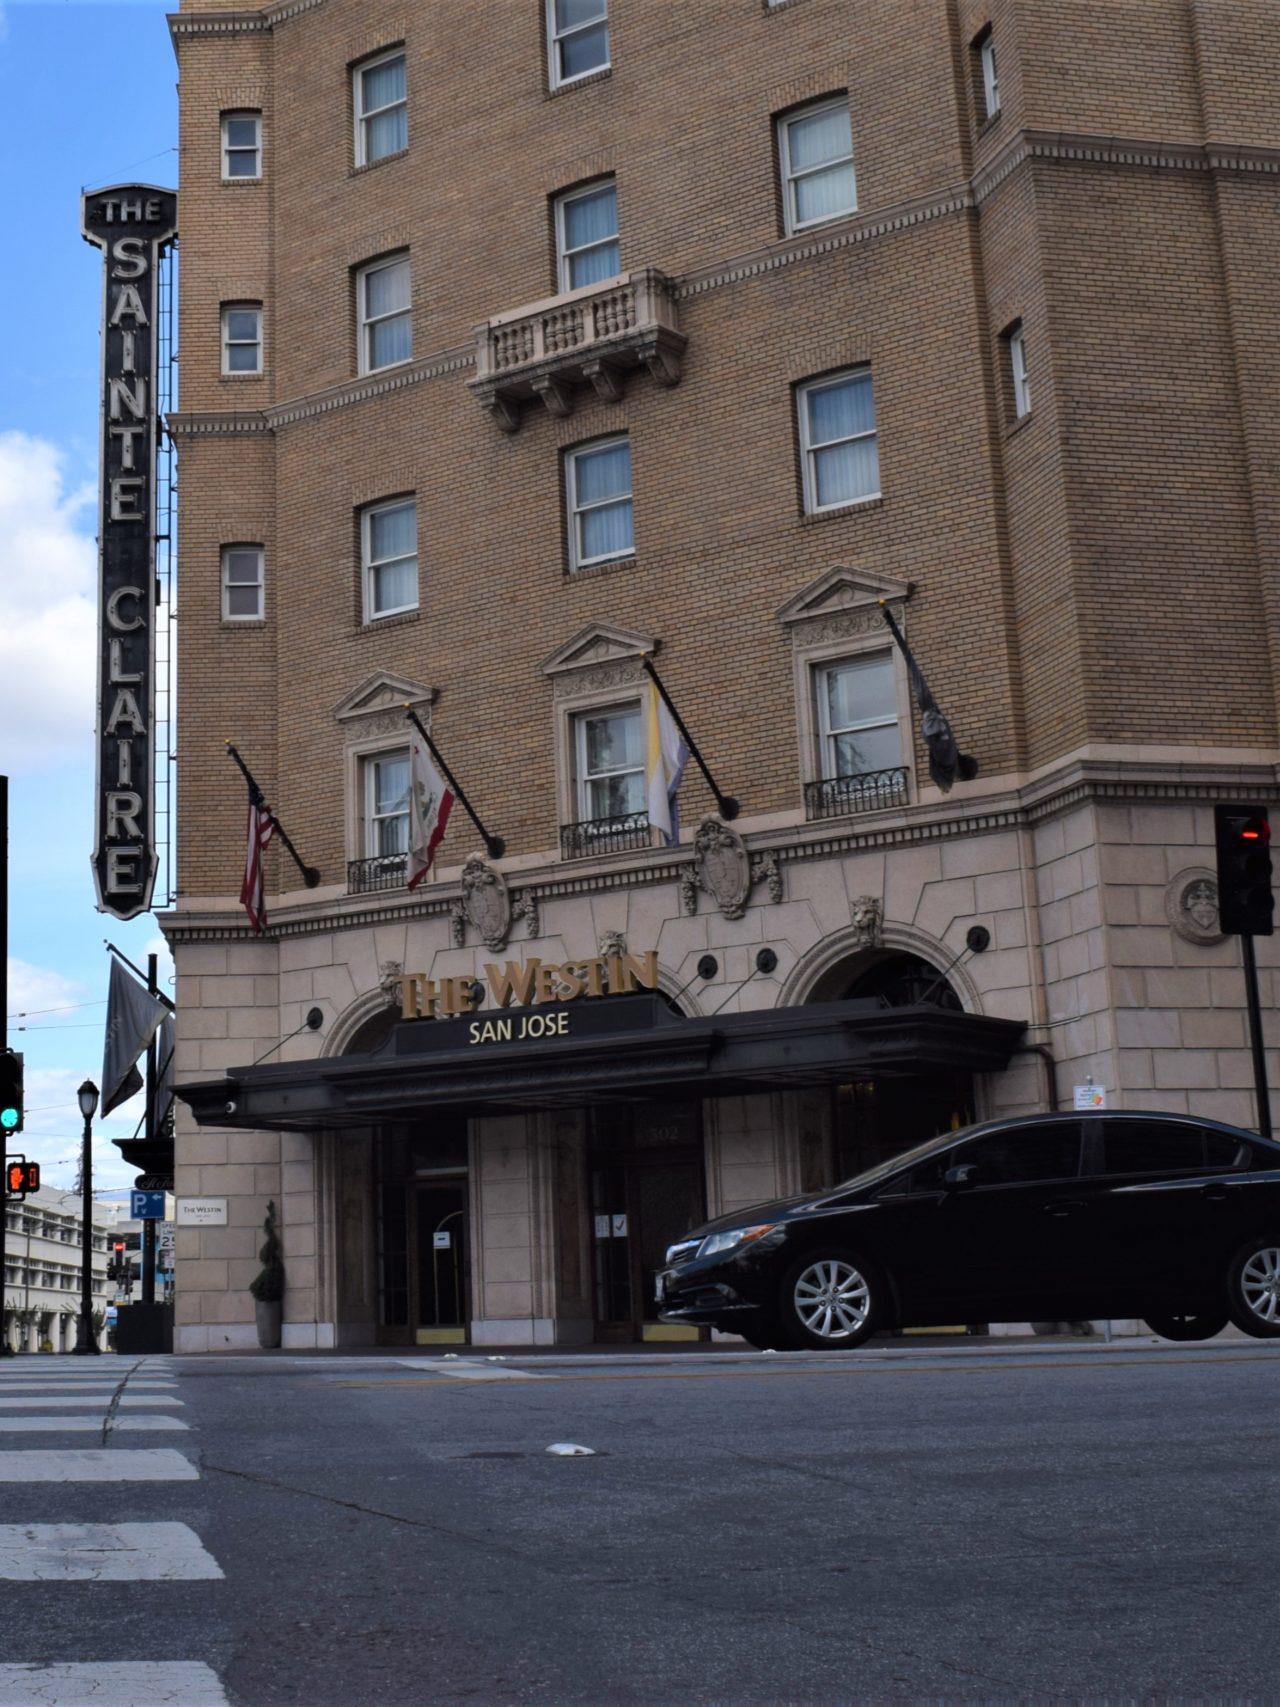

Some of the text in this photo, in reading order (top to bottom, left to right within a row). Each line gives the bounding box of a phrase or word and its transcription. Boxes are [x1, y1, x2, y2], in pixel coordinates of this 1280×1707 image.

[100, 199, 161, 222] THE
[104, 236, 150, 896] SAINTE CLAIRE
[394, 950, 659, 1019] THE WESTIN
[469, 1012, 570, 1045] SAN JOSE
